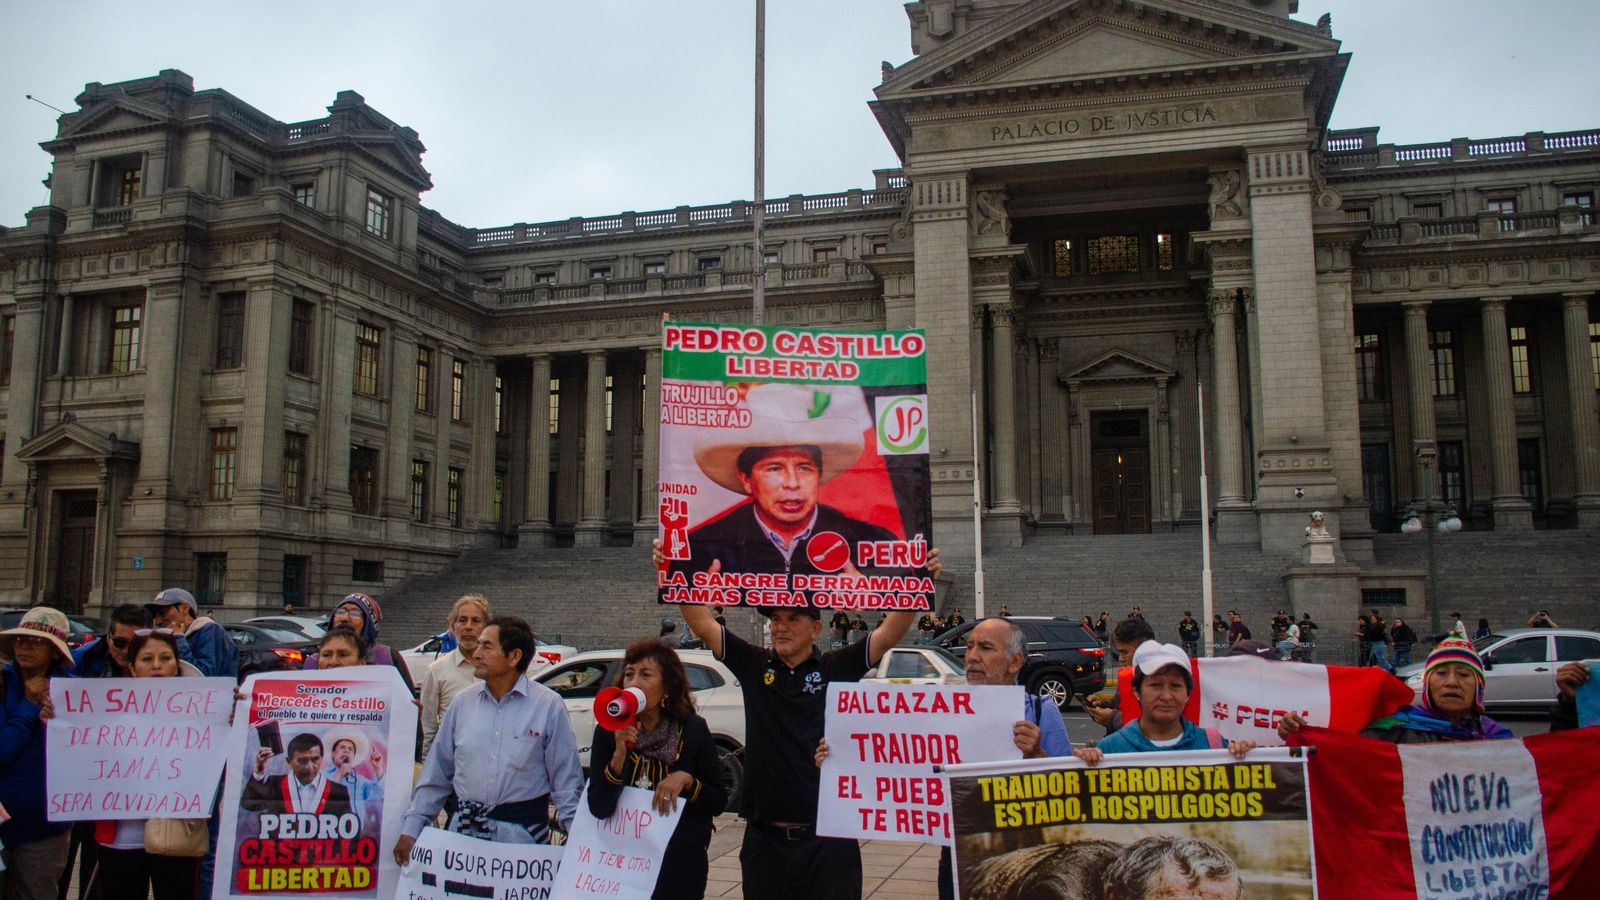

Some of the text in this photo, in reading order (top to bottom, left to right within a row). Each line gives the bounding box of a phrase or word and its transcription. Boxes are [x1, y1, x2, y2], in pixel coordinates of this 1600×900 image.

[991, 119, 1080, 140] PALACIO
[1090, 115, 1115, 132] DE
[665, 327, 924, 357] PEDRO CASTILLO
[727, 358, 858, 379] LIBERTAD
[662, 384, 739, 406] TRUJILLO
[672, 408, 752, 428] LIBERTAD
[857, 533, 927, 568] PERÚ
[659, 571, 935, 593] LA SANGRE DERRAMADA
[663, 587, 930, 610] JAMAS SERA OLVIDADA
[64, 688, 219, 715] LA SANGRE
[257, 693, 386, 711] Mercedes Castillo
[296, 685, 348, 695] Senador
[837, 690, 976, 714] BALCAZAR
[258, 710, 383, 723] el pueblo te quiere y respalda
[1236, 704, 1309, 729] PER
[65, 725, 213, 750] DERRAMADA
[850, 732, 961, 765] TRAIDOR
[88, 756, 184, 781] JAMAS
[838, 775, 863, 800] EL
[977, 764, 1277, 801] TRAIDOR TERRORISTA DEL
[1429, 771, 1511, 815] NUEVA
[50, 791, 202, 815] SERA OLVIDADA
[994, 792, 1264, 828] ESTADO, ROSPULGOSOS
[258, 812, 360, 840] PEDRO
[858, 808, 888, 832] TE
[239, 838, 377, 865] CASTILLO
[411, 845, 433, 866] UNA
[578, 846, 591, 864] YA
[628, 856, 652, 873] OTRA
[248, 866, 371, 890] LIBERTAD
[576, 872, 620, 896] LACAYA
